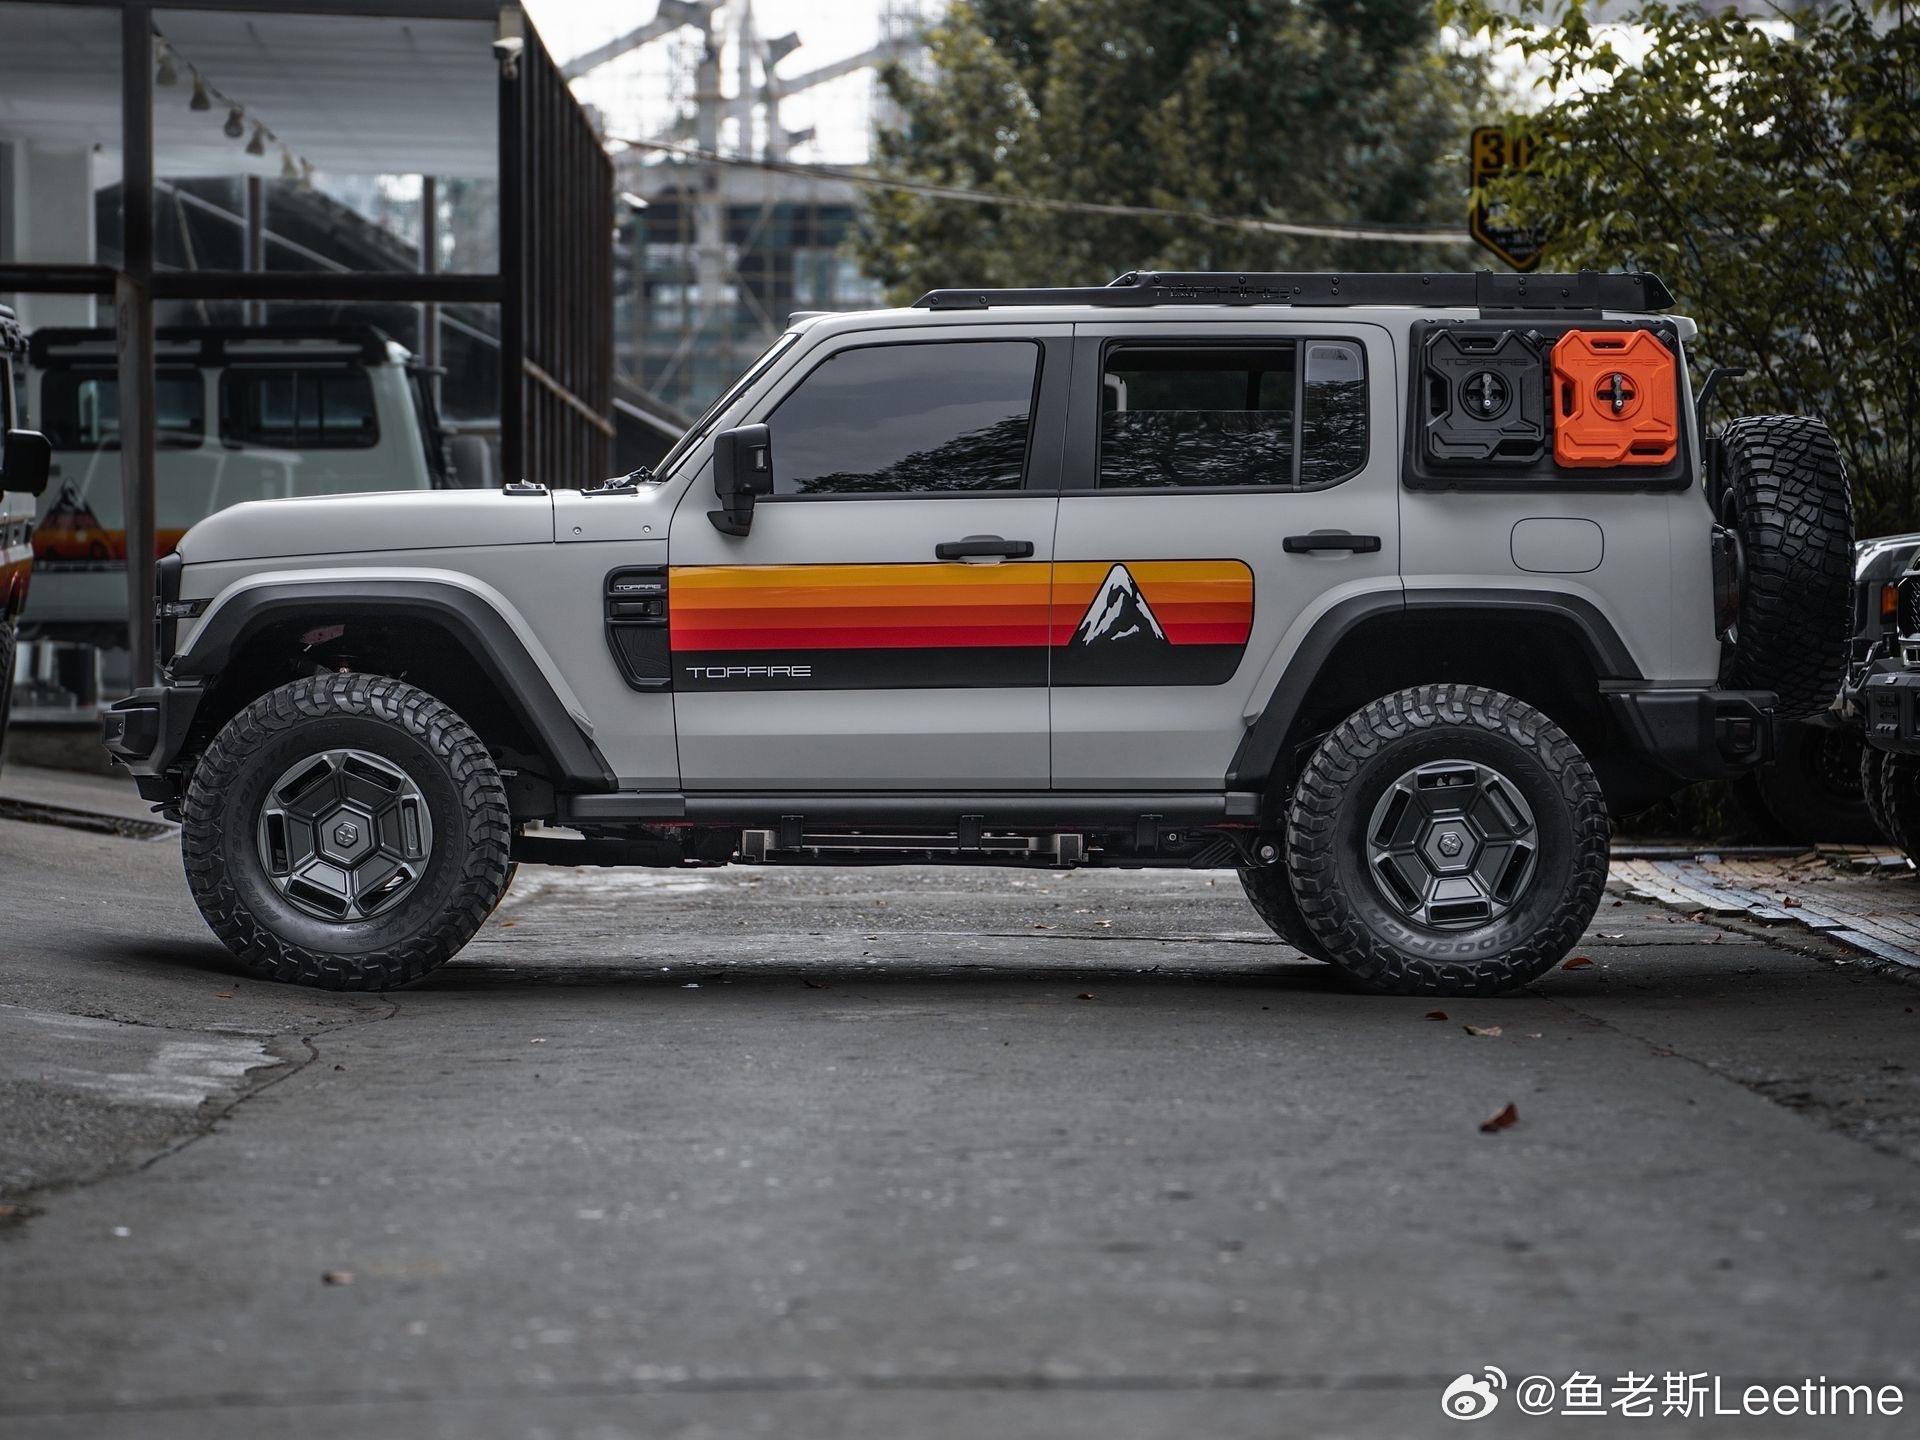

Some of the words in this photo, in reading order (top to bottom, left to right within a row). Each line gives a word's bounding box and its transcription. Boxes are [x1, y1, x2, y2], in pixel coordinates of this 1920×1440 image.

[1440, 358, 1528, 367] TOPFIRE
[1571, 358, 1659, 367] TOPFIRE
[685, 665, 812, 680] TOPFIRE
